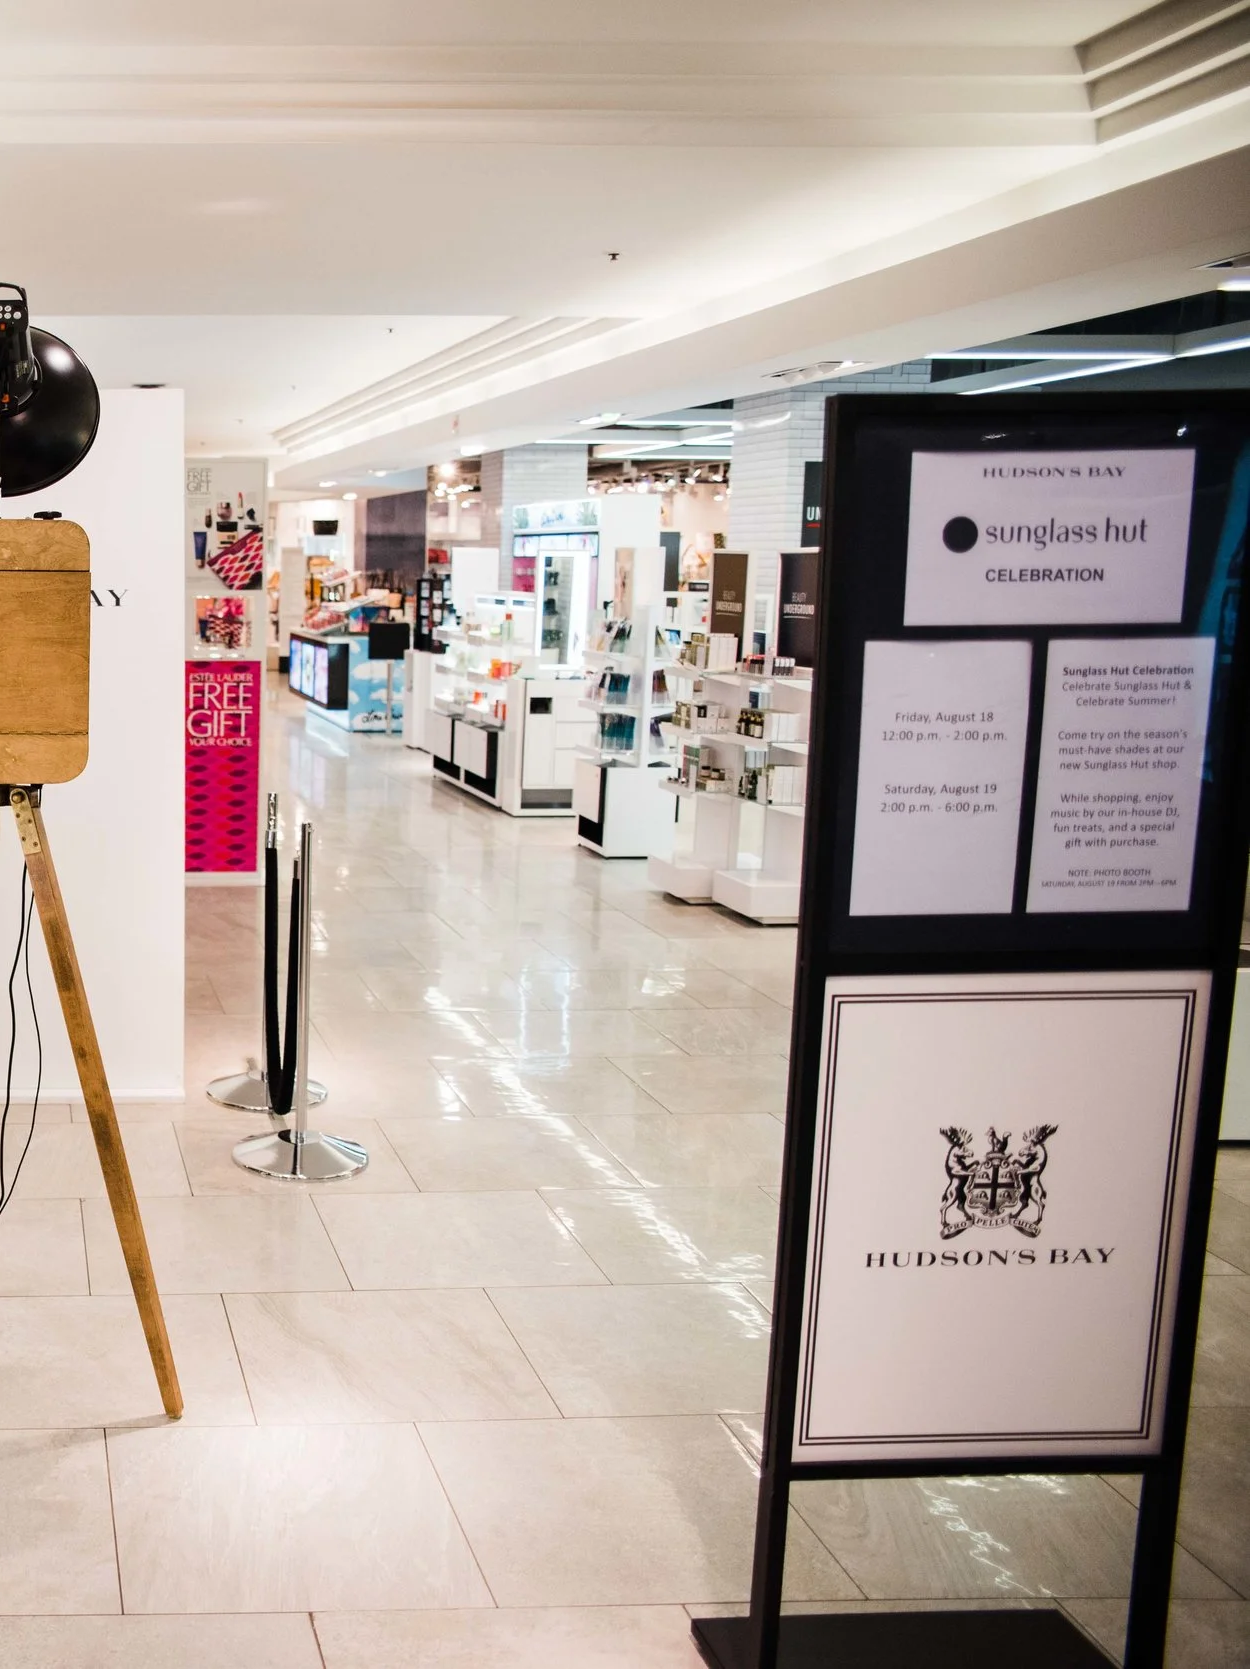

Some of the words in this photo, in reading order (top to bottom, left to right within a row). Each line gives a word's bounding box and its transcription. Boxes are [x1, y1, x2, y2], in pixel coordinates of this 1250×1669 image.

[983, 466, 1082, 478] HUDSON'S
[1088, 465, 1126, 478] BAY
[985, 517, 1098, 551] sunglass
[1104, 516, 1148, 543] hut
[985, 568, 1105, 582] CELEBRATION
[1063, 666, 1108, 678] Sunglass
[1110, 666, 1129, 675] Hut
[1132, 665, 1194, 675] Celebration
[1062, 681, 1111, 691] Celebrate
[1114, 681, 1158, 692] Sunglass
[1162, 681, 1180, 690] Hut
[1183, 680, 1192, 690] &
[189, 682, 253, 710] FREE
[1076, 696, 1125, 706] Celebrate
[1128, 696, 1176, 706] Summer!
[187, 709, 253, 737] GIFT
[895, 712, 931, 724] Friday,
[935, 712, 975, 725] August
[981, 712, 994, 722] 18
[882, 730, 914, 741] 12:00
[916, 732, 941, 742] p.m.
[954, 730, 979, 741] 2:00
[982, 732, 1007, 742] p.m.
[1058, 730, 1087, 740] Come
[1090, 731, 1105, 741] try
[1123, 729, 1141, 739] the
[1144, 729, 1188, 739] season's
[1058, 745, 1111, 755] must-have
[1115, 744, 1150, 754] shades
[1153, 745, 1163, 754] at
[1166, 746, 1185, 754] our
[1060, 762, 1081, 770] new
[1084, 760, 1127, 771] Sunglass
[1130, 760, 1149, 769] Hut
[1152, 759, 1180, 770] shop.
[884, 784, 936, 796] Saturday,
[940, 783, 979, 796] August
[984, 783, 997, 794] 19
[1060, 793, 1089, 803] While
[1092, 793, 1142, 804] shopping,
[1145, 792, 1174, 804] enjoy
[880, 802, 906, 812] 2:00
[908, 803, 933, 814] p.m.
[945, 802, 970, 812] 6:00
[973, 803, 998, 814] p.m.
[1050, 809, 1080, 818] music
[1083, 808, 1095, 819] by
[1097, 809, 1115, 817] our
[1117, 807, 1162, 817] in-house
[1165, 807, 1180, 818] DJ,
[1053, 823, 1070, 832] fun
[1073, 823, 1105, 833] treats,
[1108, 822, 1128, 832] and
[1130, 824, 1136, 832] a
[1139, 822, 1175, 833] special
[1065, 838, 1082, 849] gift
[1085, 838, 1107, 847] with
[1110, 837, 1159, 848] purchase.
[1094, 869, 1121, 877] PHOTO
[1123, 868, 1151, 877] BOOTH
[1041, 881, 1076, 889] SATURDAY,
[1116, 880, 1137, 888] FROM
[865, 1249, 1036, 1268] HUDSON'S
[1049, 1248, 1115, 1265] BAY
